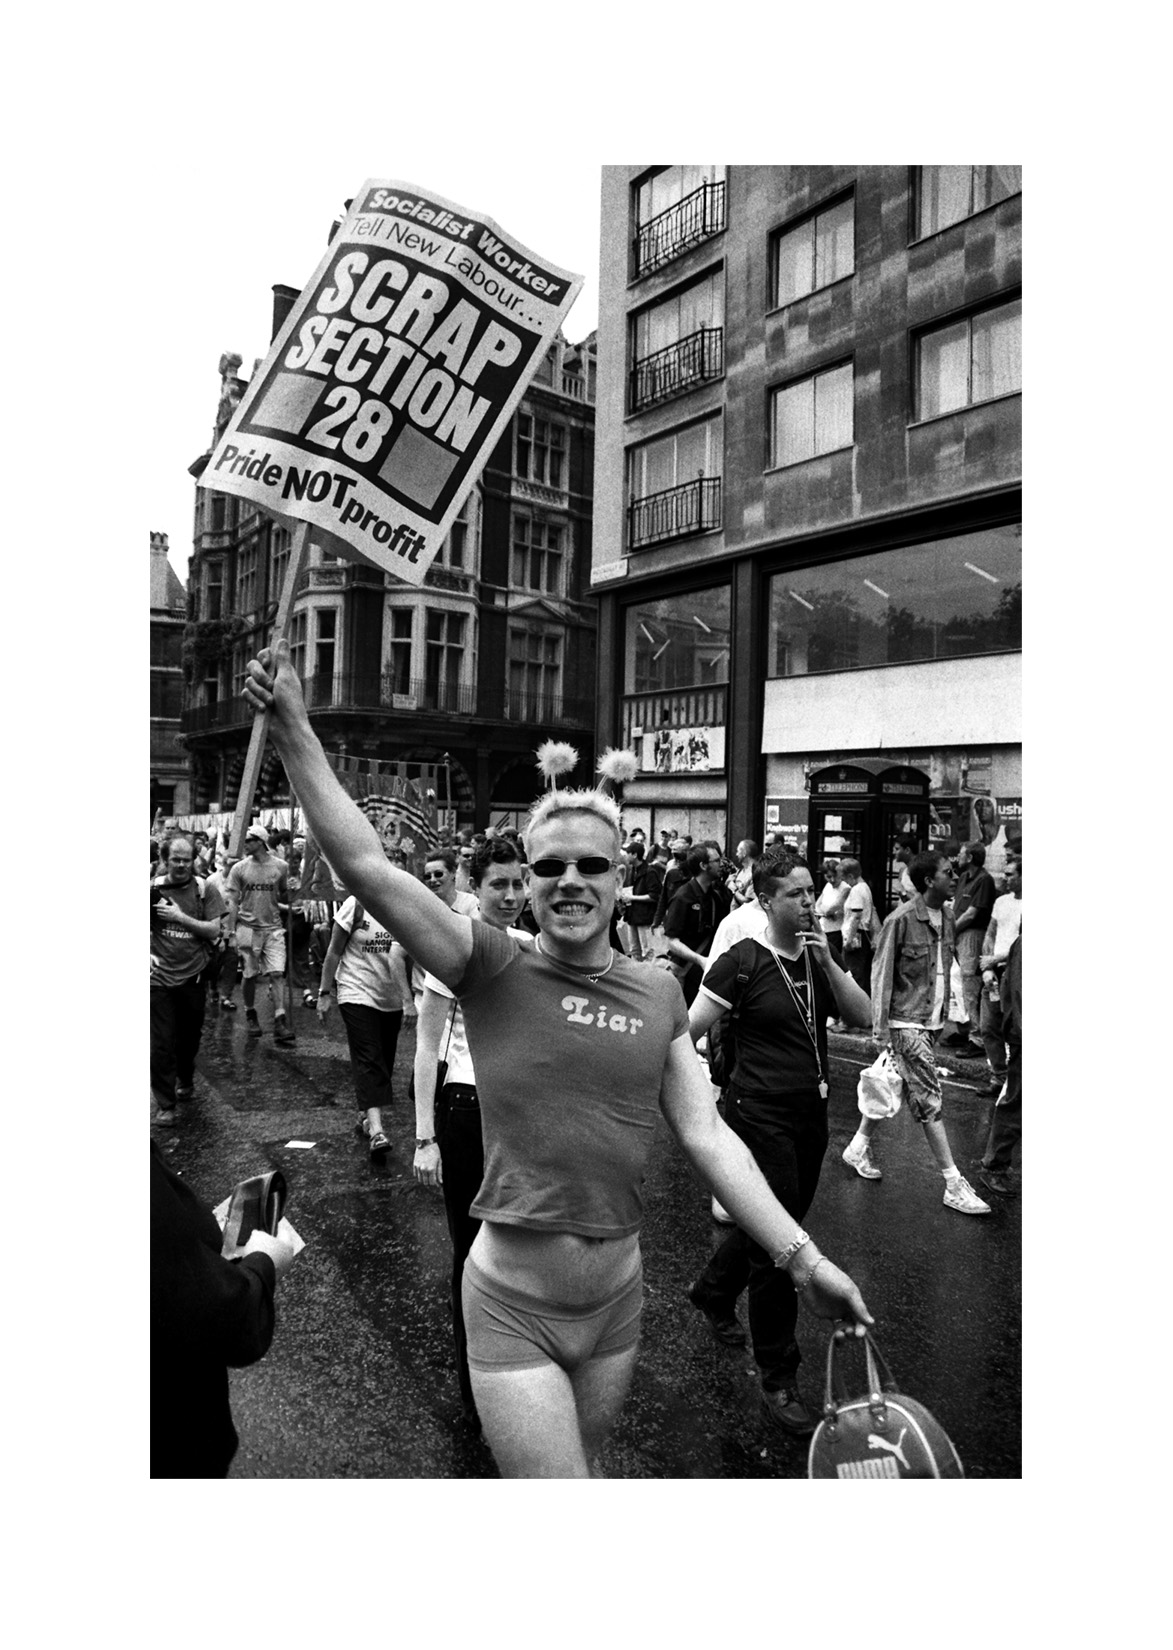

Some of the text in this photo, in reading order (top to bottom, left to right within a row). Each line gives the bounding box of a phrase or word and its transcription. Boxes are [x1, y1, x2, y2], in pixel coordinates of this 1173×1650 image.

[351, 217, 543, 326] Tell New Labour...
[369, 189, 560, 298] Socialist Worker
[316, 251, 522, 387] SCRAP
[284, 315, 491, 453] SECTION
[305, 385, 394, 464] 28
[214, 444, 430, 565] Pride NOT profit
[998, 803, 1022, 815] ush
[244, 883, 274, 892] ACCESS
[561, 995, 643, 1035] Liar
